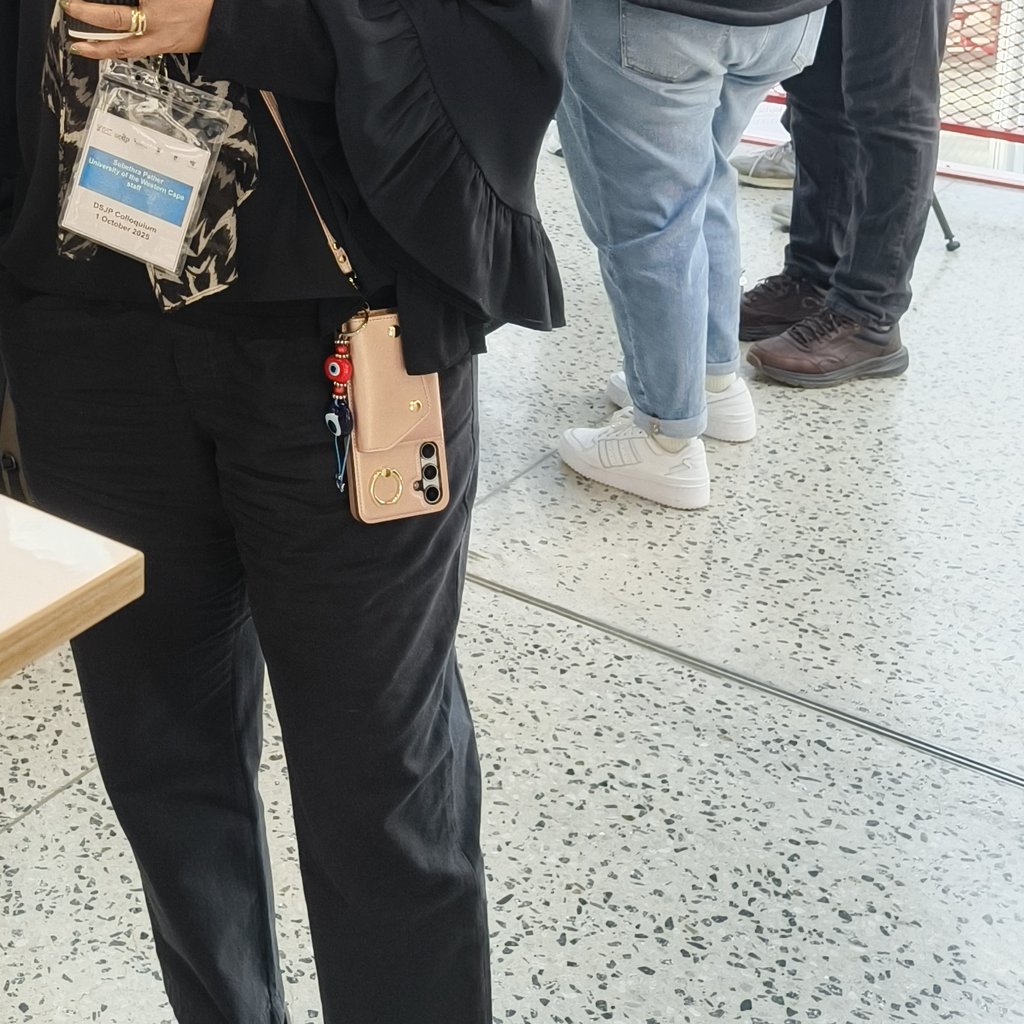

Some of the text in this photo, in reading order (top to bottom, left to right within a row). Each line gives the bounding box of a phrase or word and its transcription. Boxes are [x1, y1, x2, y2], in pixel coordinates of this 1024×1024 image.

[88, 157, 121, 176] University
[128, 173, 139, 183] the
[140, 178, 167, 194] Western
[167, 189, 185, 201] Cape
[93, 201, 157, 233] DSJP Colloquium
[101, 215, 131, 232] October
[132, 228, 151, 240] 2025
